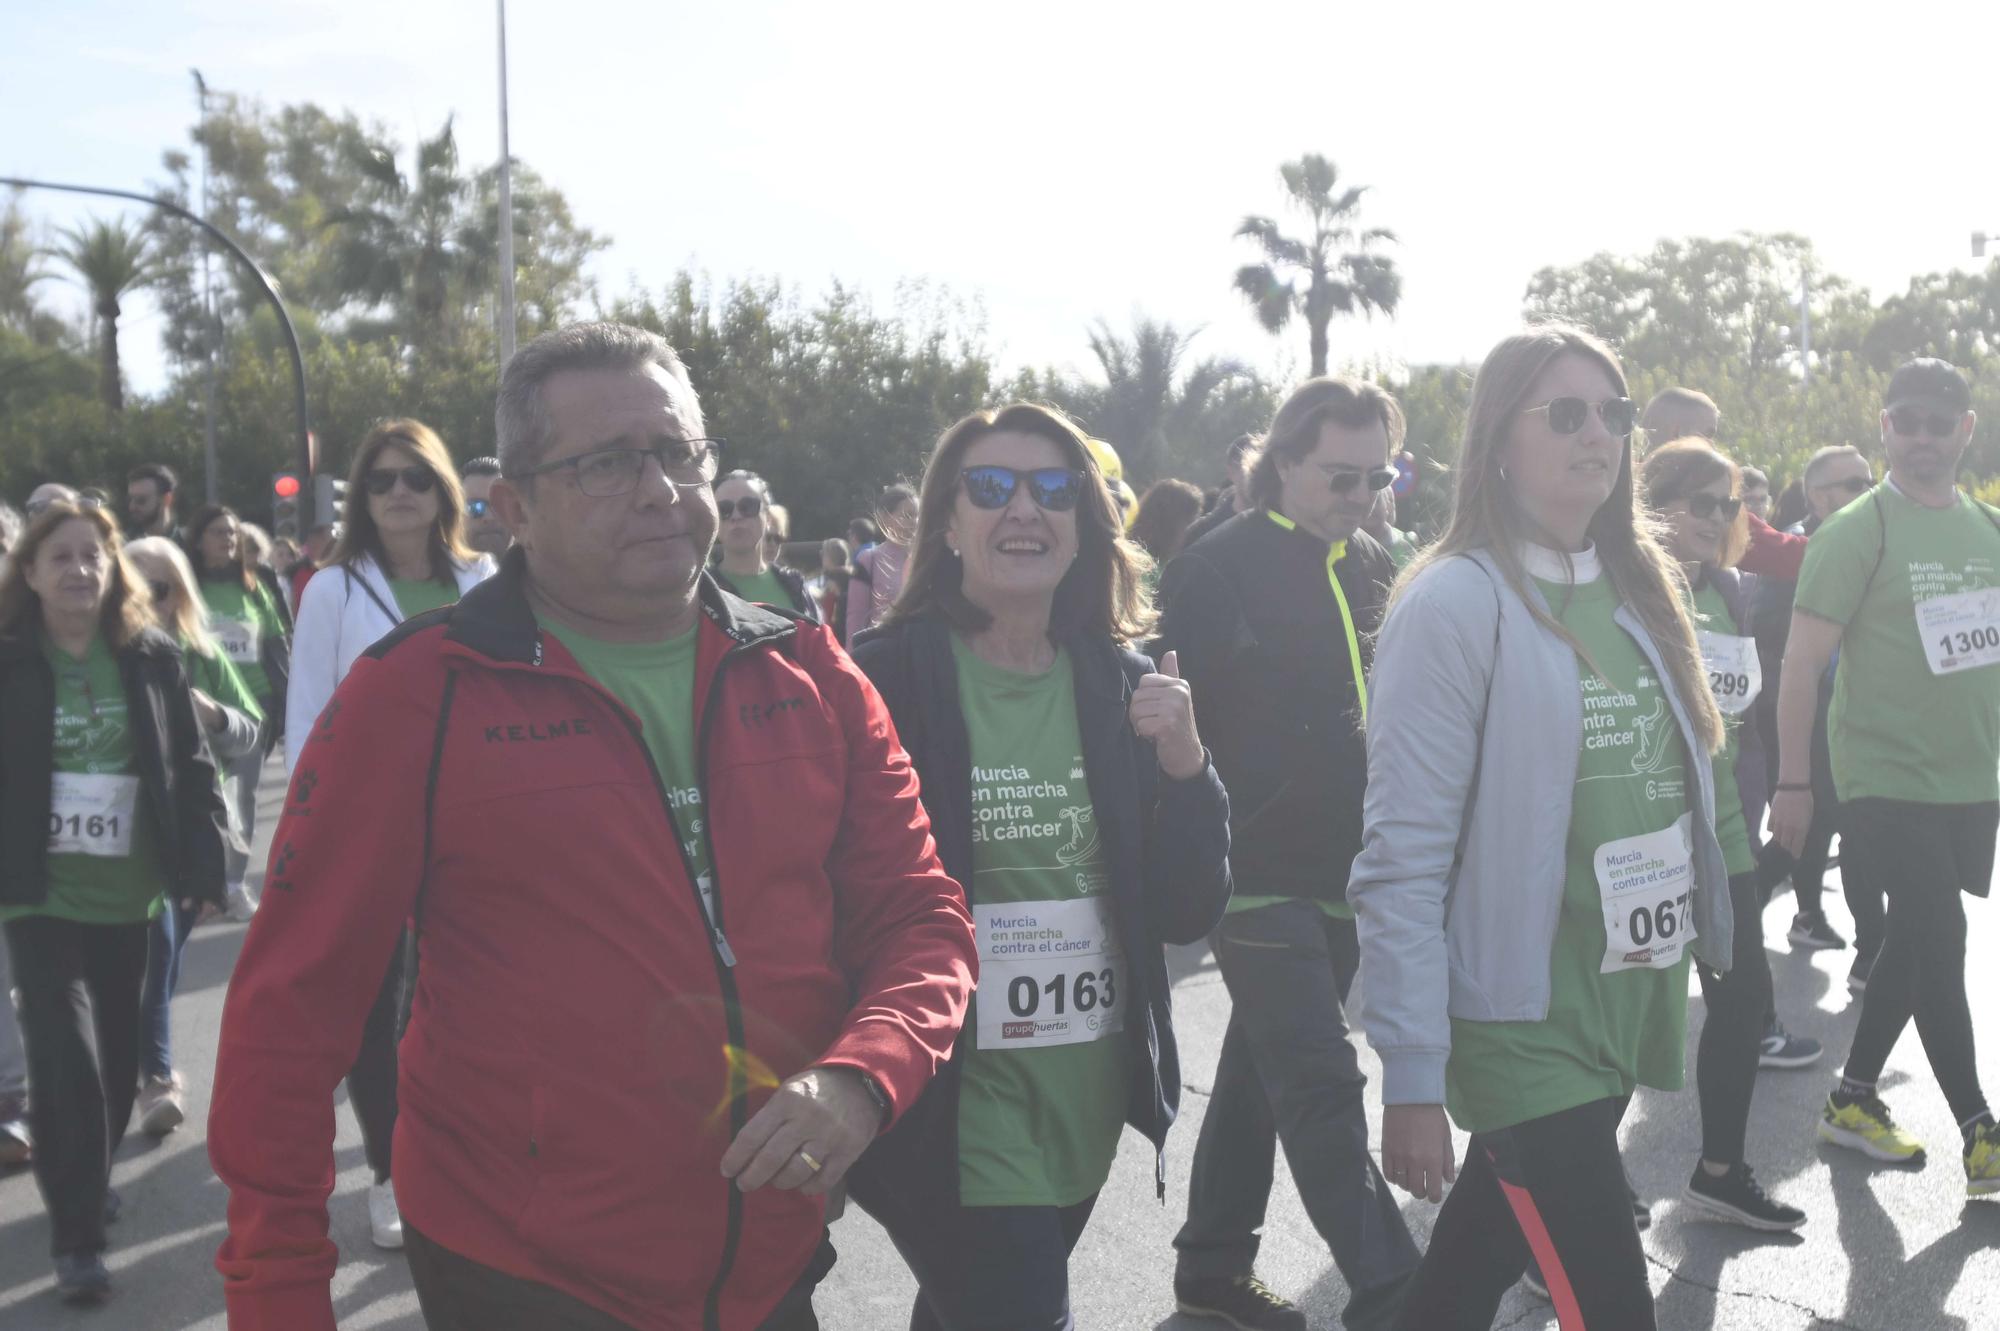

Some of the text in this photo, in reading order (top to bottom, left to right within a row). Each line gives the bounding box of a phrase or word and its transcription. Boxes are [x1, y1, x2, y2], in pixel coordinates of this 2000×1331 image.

[1940, 625, 2000, 656] 1300
[1584, 693, 1637, 710] marcha
[484, 718, 592, 743] KELME
[997, 780, 1069, 800] marcha
[993, 821, 1063, 841] cáncer
[1605, 850, 1643, 868] Murcia
[1608, 857, 1666, 879] en marcha
[1612, 874, 1647, 891] contra
[1647, 871, 1657, 883] el
[990, 916, 1037, 929] Murcia
[991, 927, 1063, 941] en marcha
[991, 939, 1091, 954] contra el cáncer
[1007, 967, 1116, 1018] 0163
